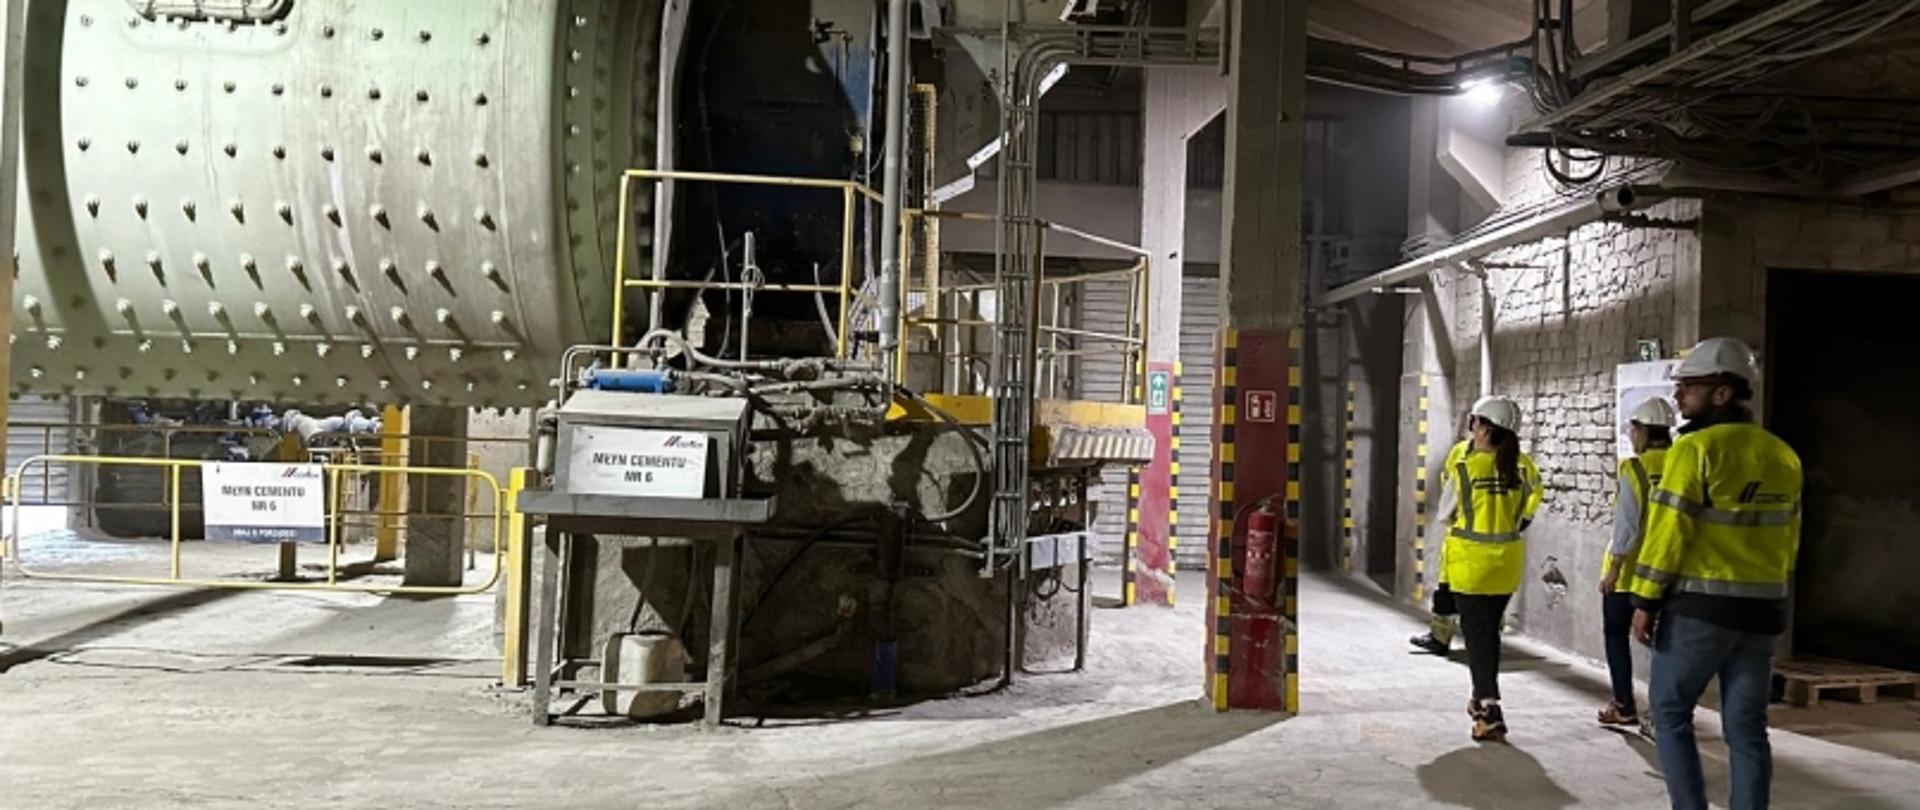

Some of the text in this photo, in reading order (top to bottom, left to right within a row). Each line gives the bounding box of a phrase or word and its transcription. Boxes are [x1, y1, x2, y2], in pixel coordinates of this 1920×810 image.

[592, 452, 686, 468] MŁYN CEMENTU
[624, 471, 653, 483] NR 6
[254, 486, 305, 497] CEMENTU
[251, 500, 277, 511] NR 6
